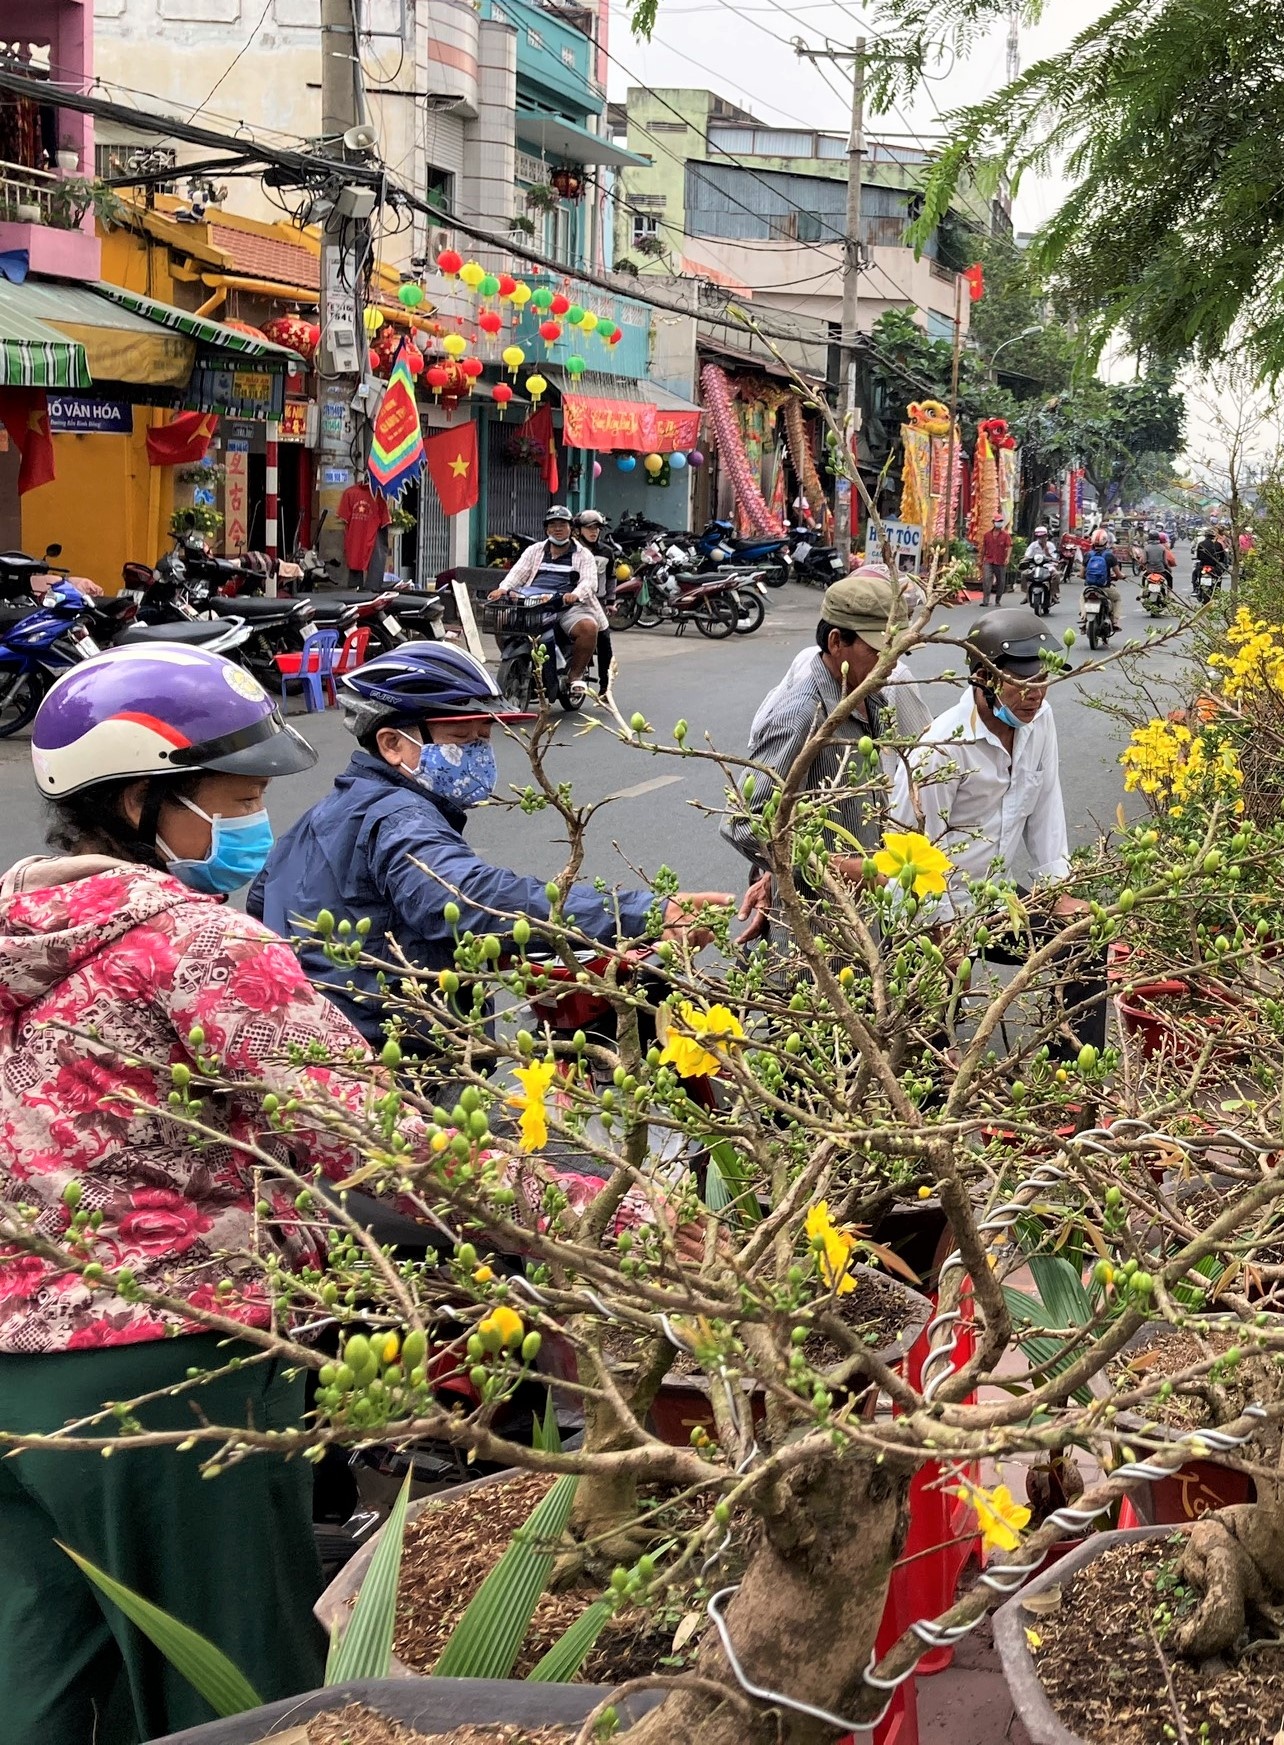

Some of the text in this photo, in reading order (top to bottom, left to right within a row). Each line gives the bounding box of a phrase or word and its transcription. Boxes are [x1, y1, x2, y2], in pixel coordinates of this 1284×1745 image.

[64, 402, 90, 418] VĂN
[93, 403, 121, 420] HÓA
[869, 523, 919, 546] HT TÓC
[370, 689, 403, 704] FURY
[1171, 1471, 1225, 1518] Tà
